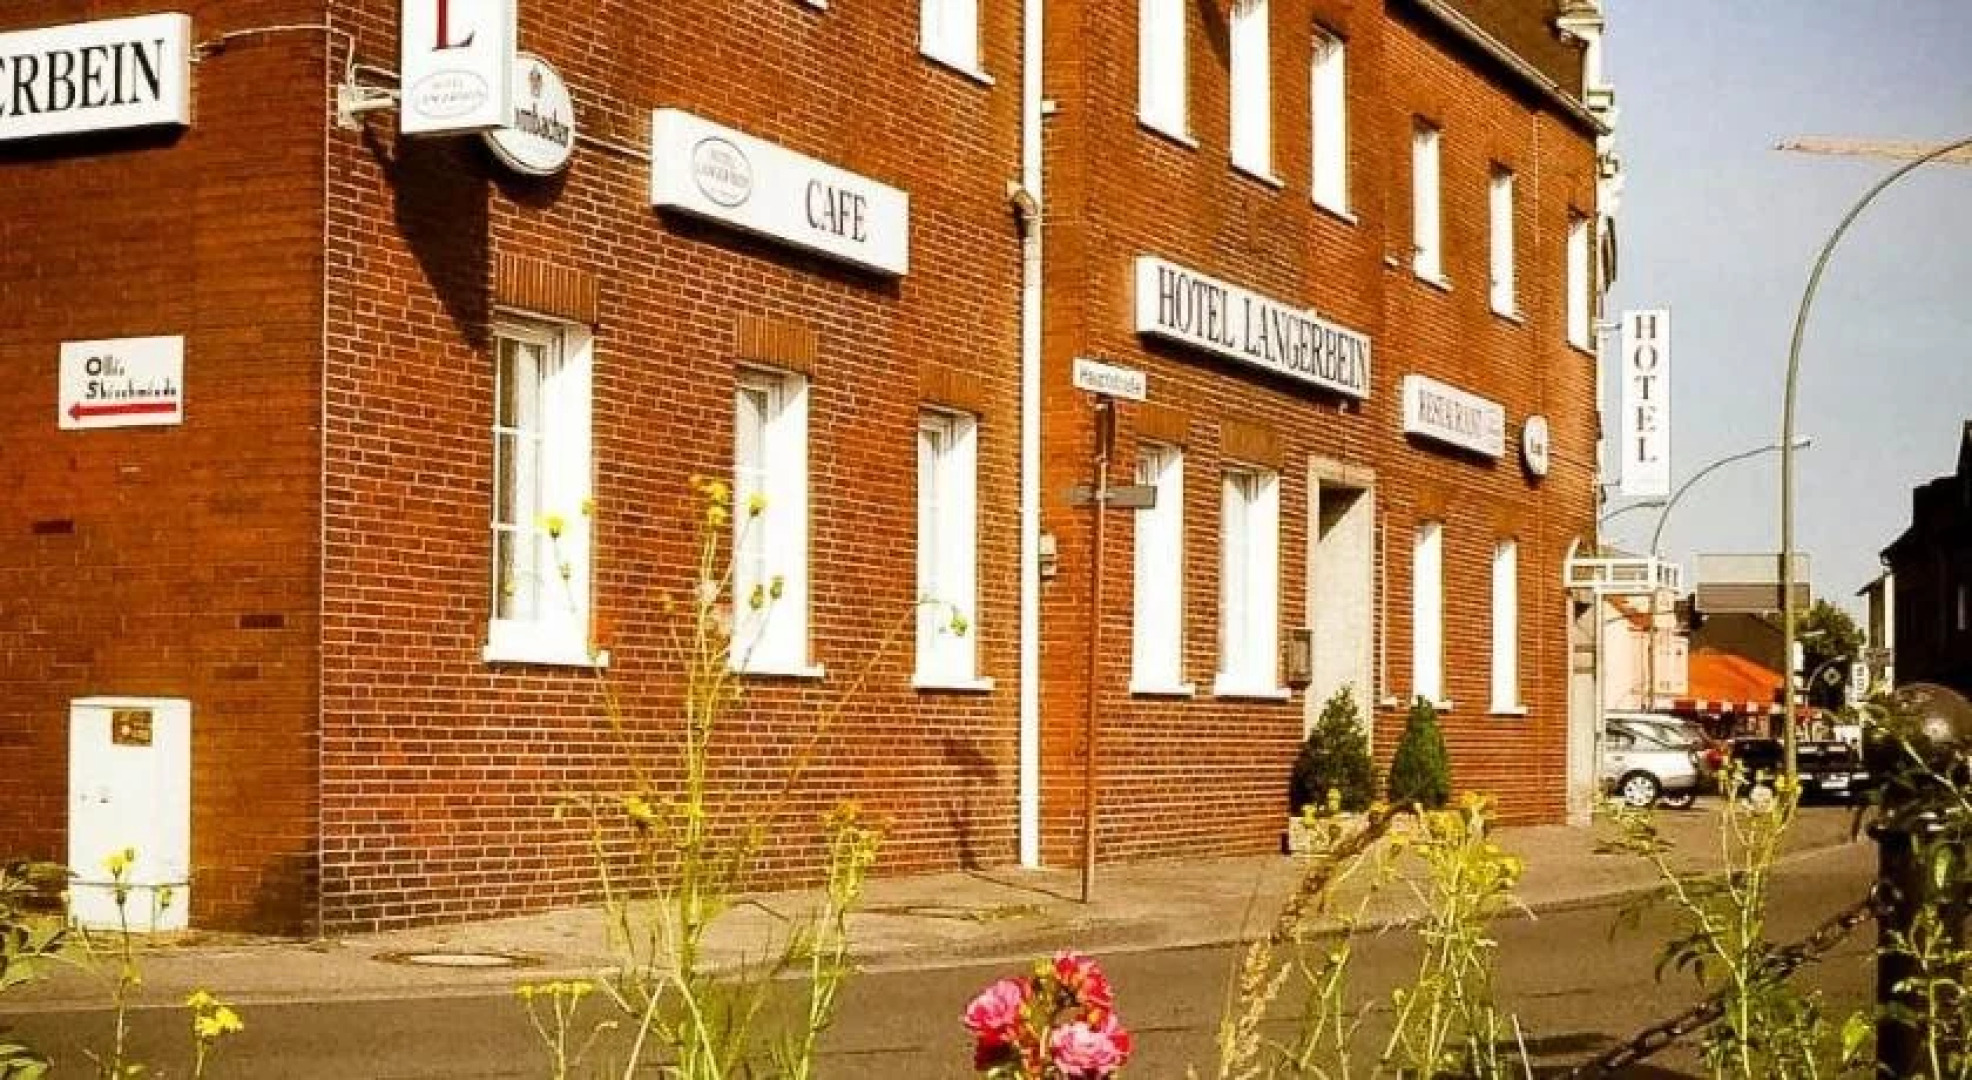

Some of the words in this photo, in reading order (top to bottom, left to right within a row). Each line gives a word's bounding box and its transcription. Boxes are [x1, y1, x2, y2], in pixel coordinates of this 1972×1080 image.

[804, 177, 868, 243] CAFE
[1157, 264, 1236, 349] HOTEL
[1244, 297, 1369, 392] LANGERBEIN
[1634, 314, 1659, 463] HOTEL
